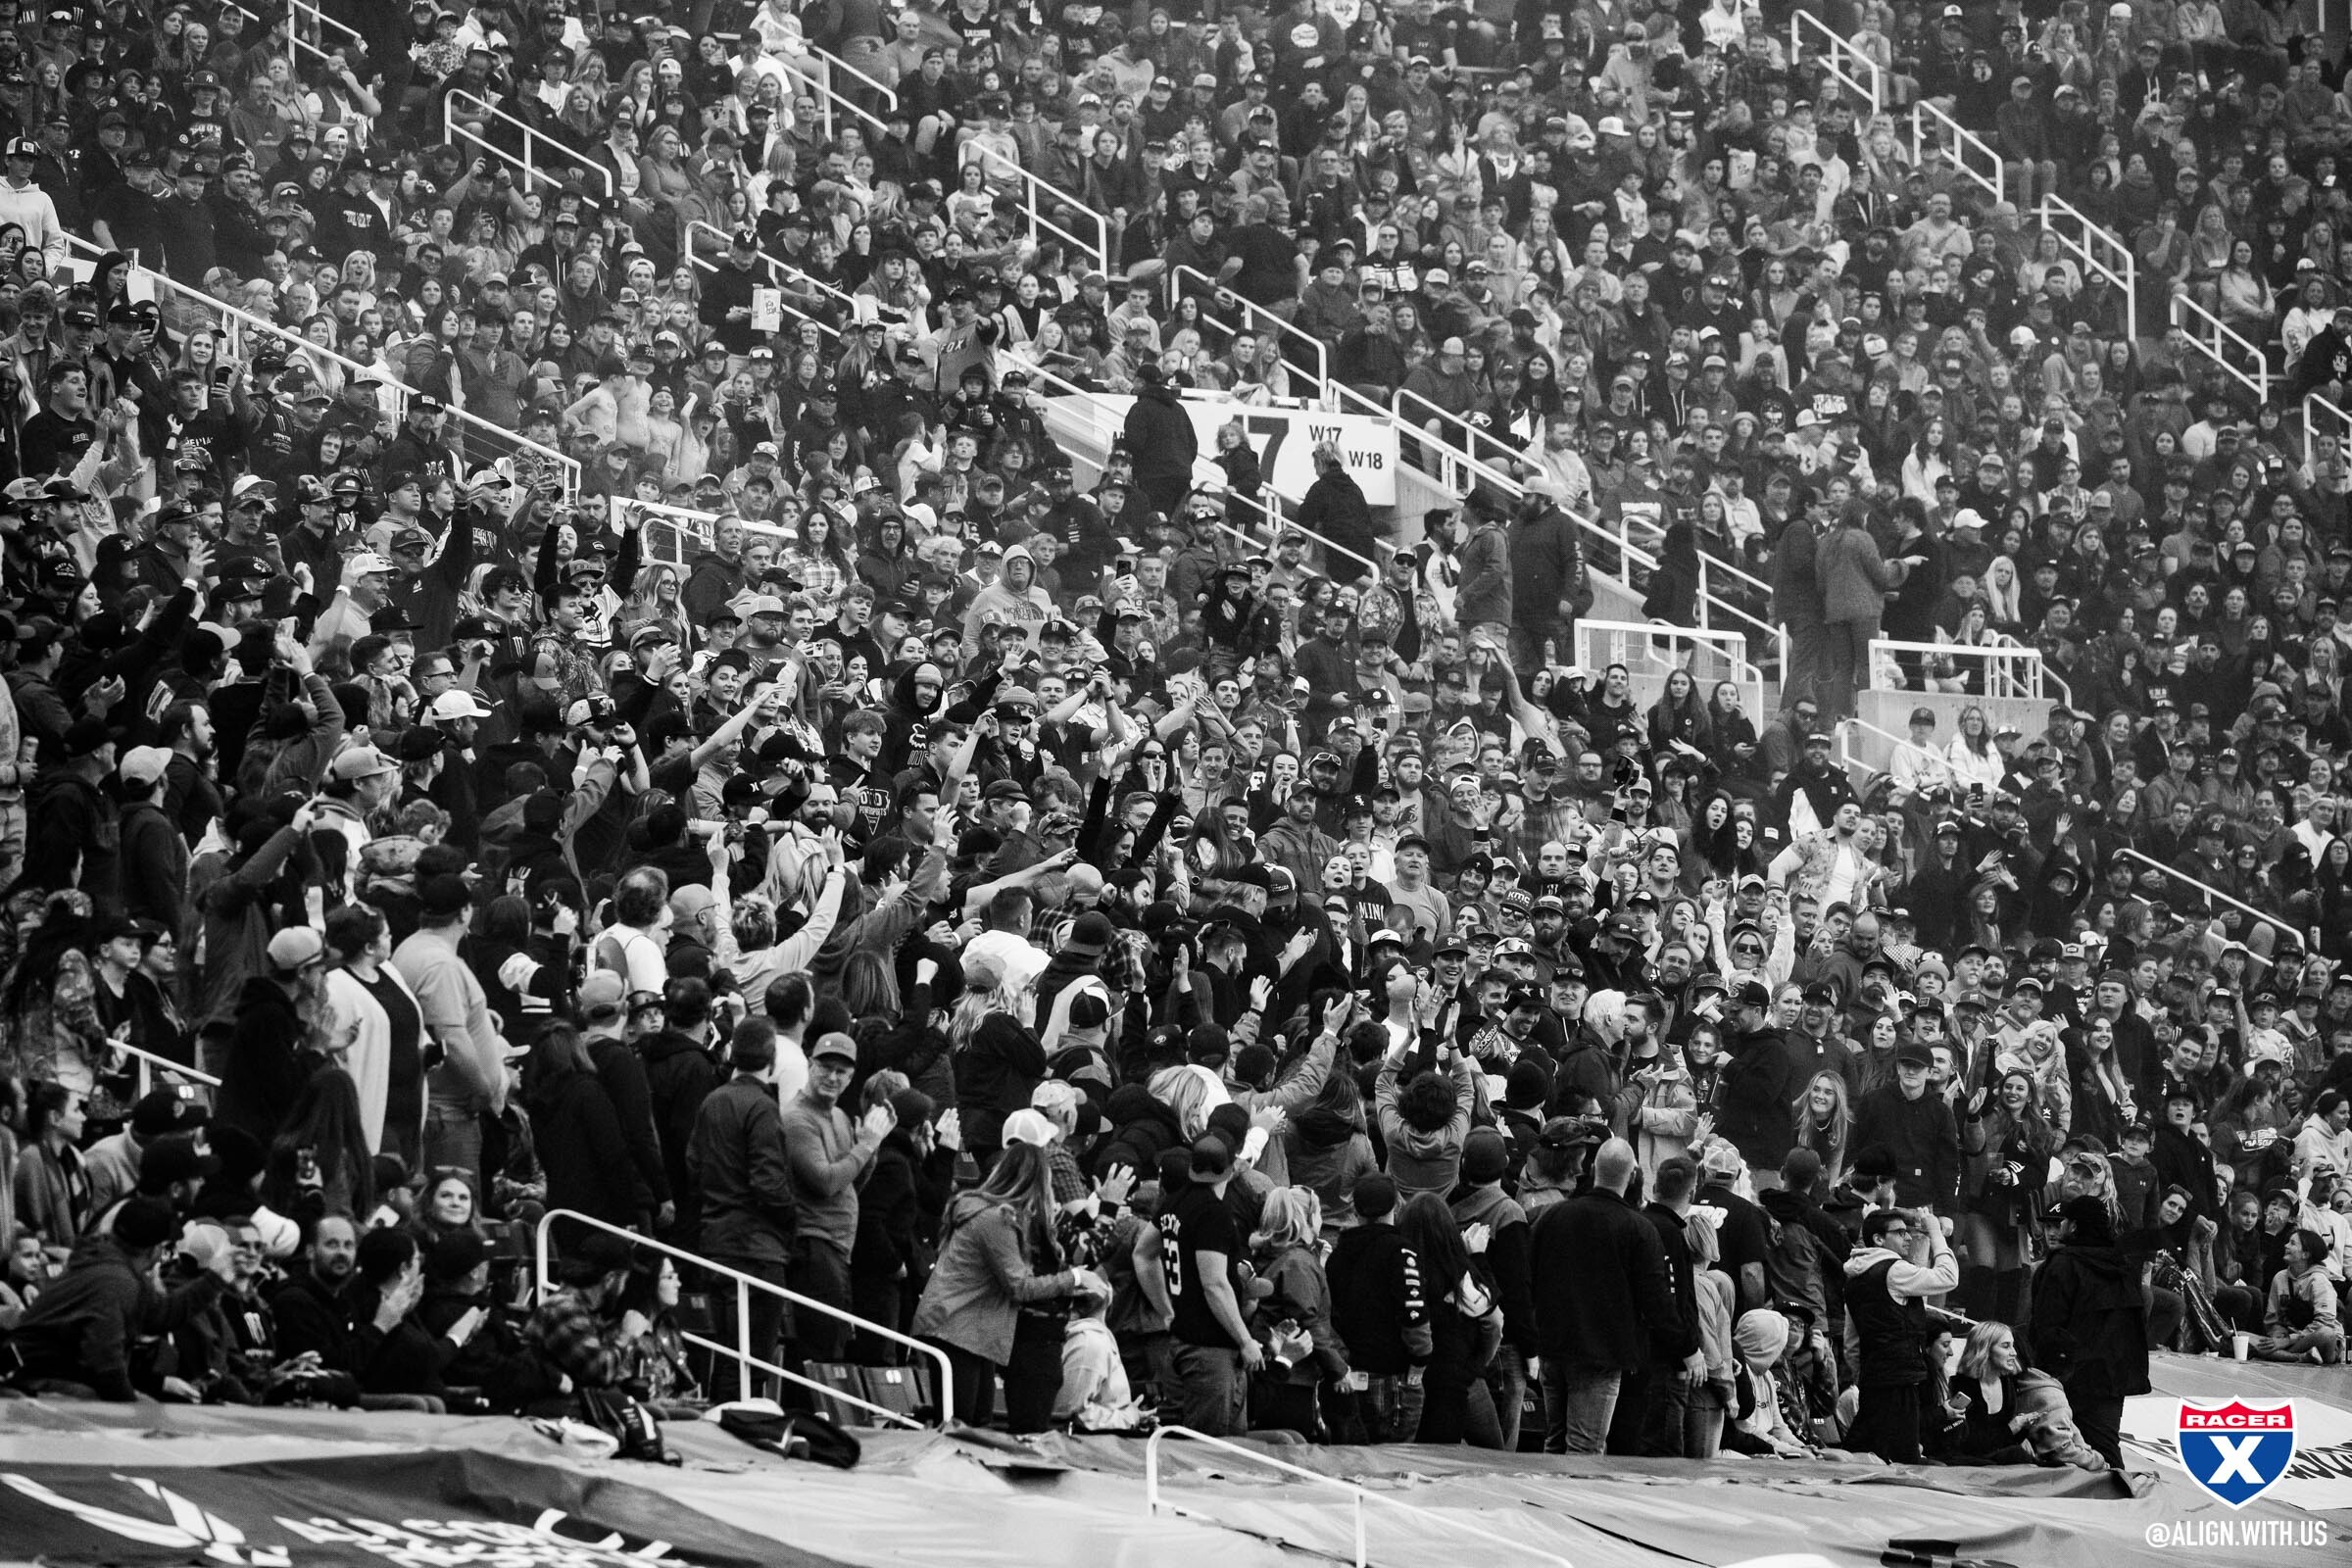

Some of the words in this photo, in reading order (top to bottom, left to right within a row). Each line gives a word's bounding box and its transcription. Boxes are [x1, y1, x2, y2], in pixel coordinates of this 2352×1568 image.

[1309, 424, 1343, 442] W17
[1233, 414, 1289, 485] 7
[1348, 450, 1383, 469] W18
[1003, 607, 1031, 615] NORTH
